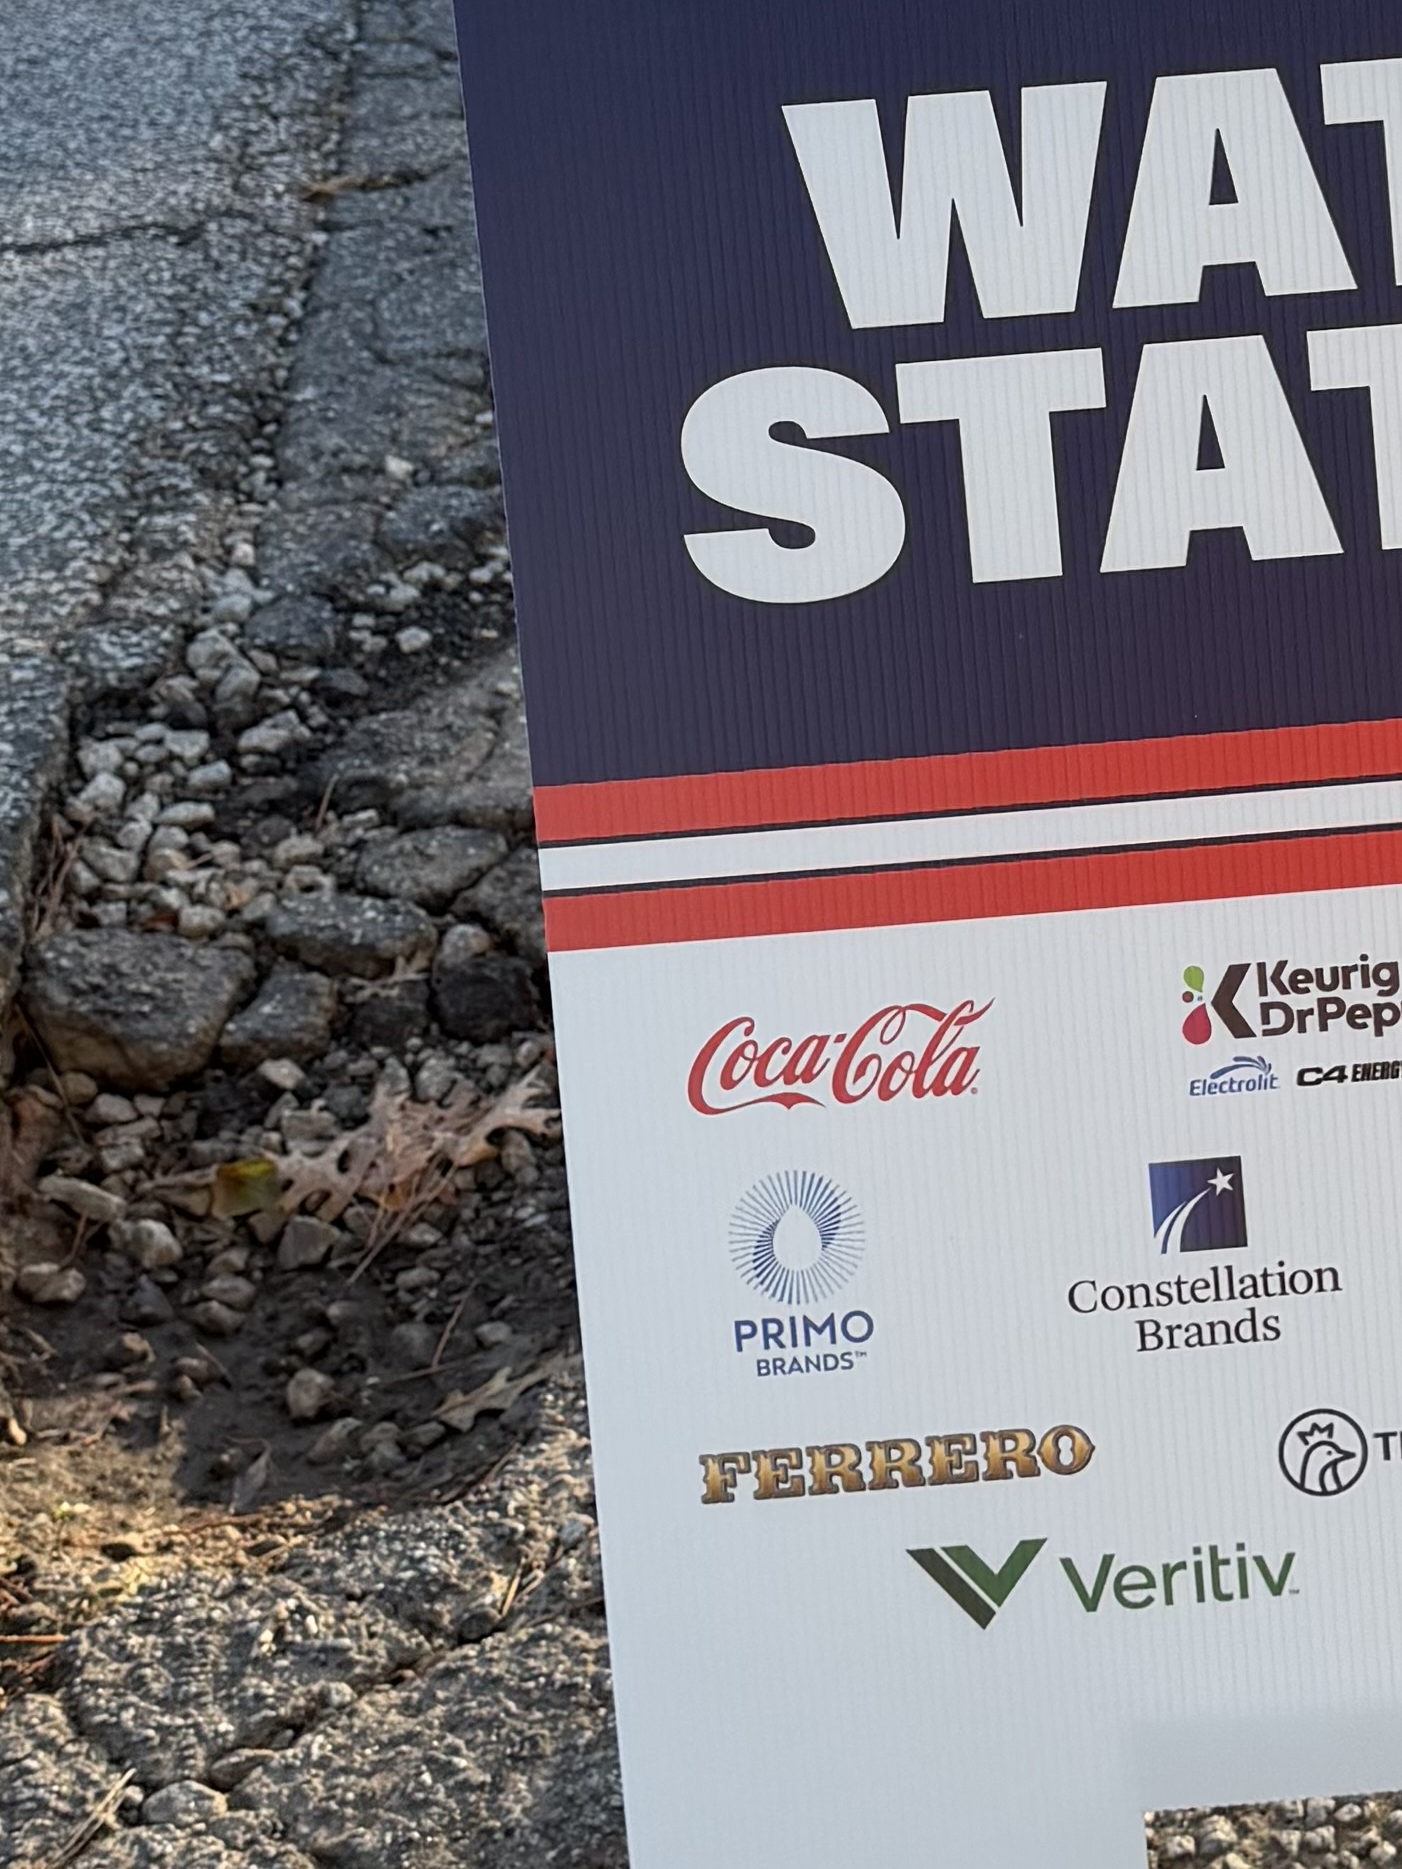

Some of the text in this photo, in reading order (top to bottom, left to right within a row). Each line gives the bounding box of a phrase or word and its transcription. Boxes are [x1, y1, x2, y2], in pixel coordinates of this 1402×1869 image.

[1256, 954, 1400, 997] Keurig
[688, 997, 996, 1115] Coca-Cola
[1296, 1065, 1349, 1087] C4
[1189, 1075, 1278, 1096] Electrolit
[1067, 1260, 1343, 1314] Constellation
[734, 1310, 875, 1353] PRIMO
[1134, 1307, 1282, 1352] Brands
[700, 1424, 1096, 1505] FERRERO
[1059, 1542, 1296, 1613] Veritiv
